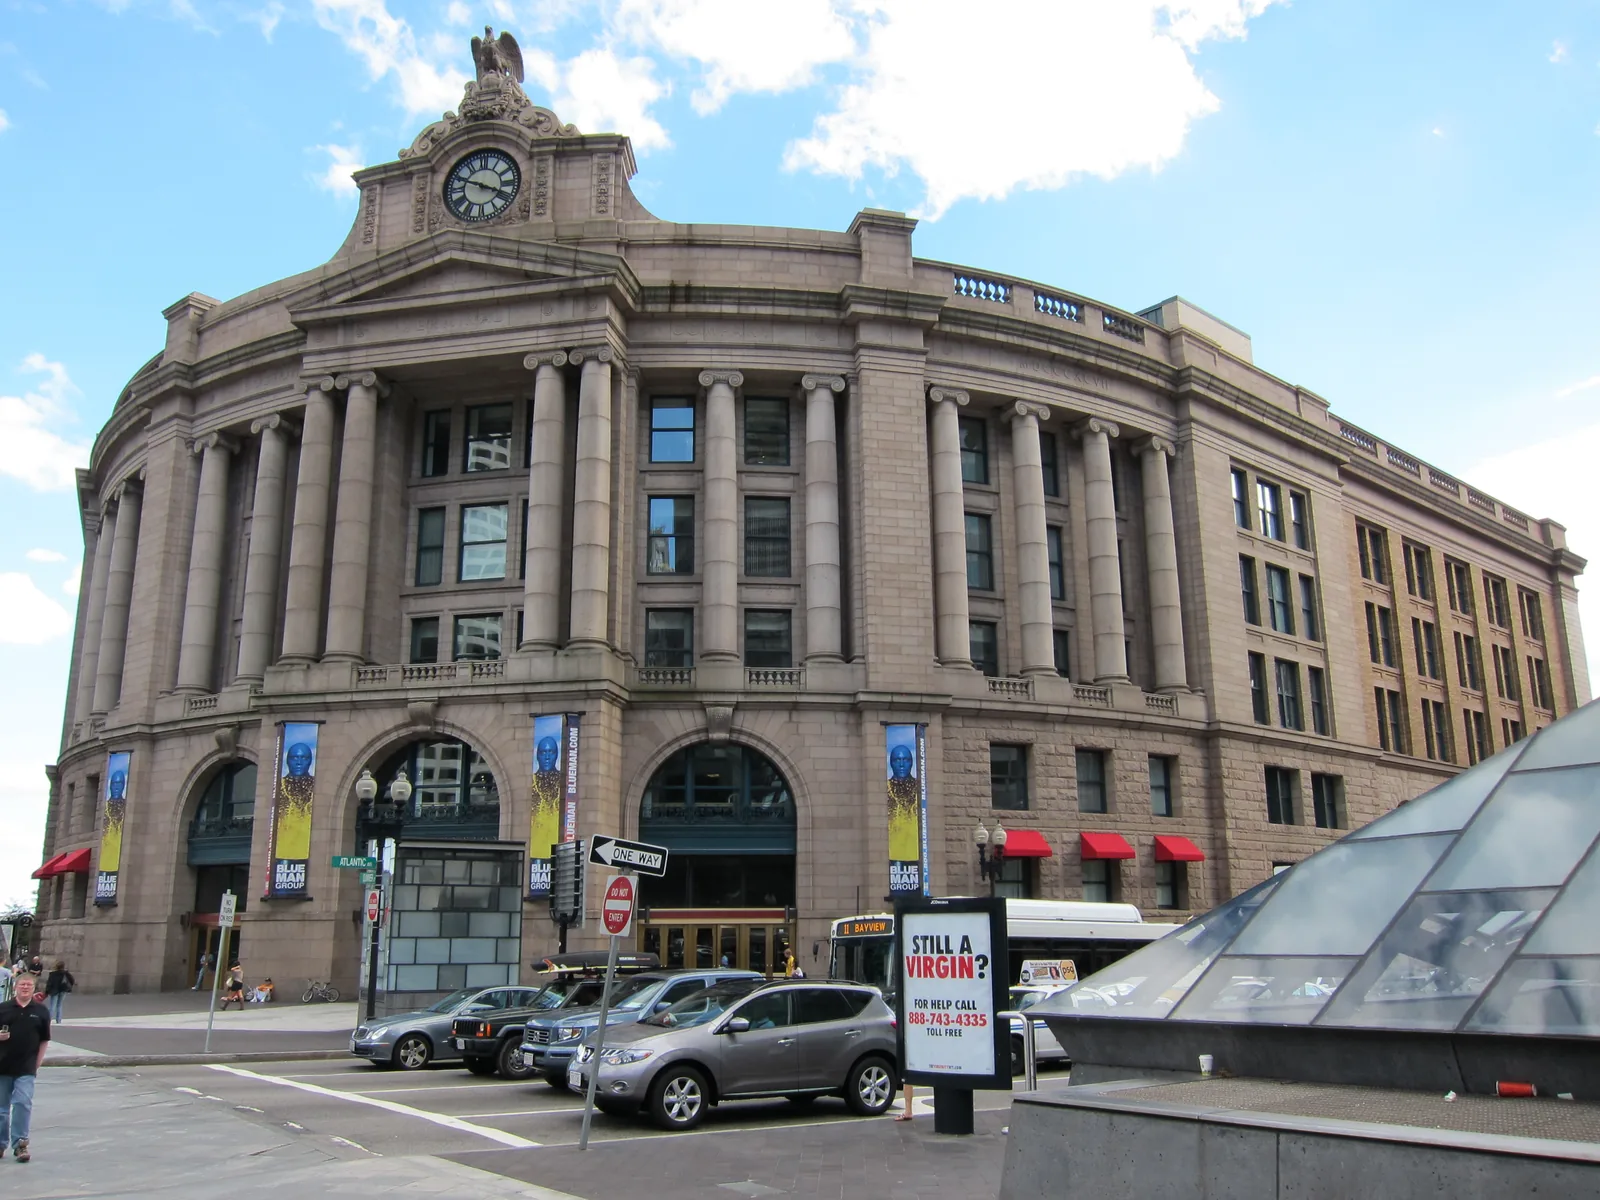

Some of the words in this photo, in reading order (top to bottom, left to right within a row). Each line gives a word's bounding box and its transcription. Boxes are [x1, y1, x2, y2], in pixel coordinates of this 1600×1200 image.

[567, 727, 578, 794] BLUEMAN.COM
[919, 737, 927, 800] BLUEMAN.COM
[566, 801, 576, 842] LUEMAN
[340, 857, 367, 867] ATLANTIC
[613, 847, 634, 862] ONE
[638, 852, 660, 867] WAY
[276, 863, 306, 873] BLUE
[531, 863, 551, 873] BLU
[890, 865, 919, 875] BLUE
[98, 875, 117, 884] BLUE
[275, 872, 305, 883] MAN
[890, 874, 919, 884] MAN
[97, 883, 116, 892] MAN
[530, 882, 551, 890] GROU
[890, 883, 919, 891] GROUP
[610, 888, 619, 897] DO
[619, 888, 629, 897] NOT
[608, 913, 624, 922] ENTER
[844, 924, 850, 935] 11
[854, 922, 887, 933] BAYVIEW
[912, 935, 954, 955] STILL
[959, 935, 973, 955] A
[905, 954, 989, 979] VIRGIN?
[914, 999, 929, 1009] FOR
[930, 1000, 953, 1010] HELP
[955, 1000, 977, 1011] CALL
[908, 1012, 988, 1027] 888-743-4335
[926, 1028, 942, 1036] TOLL
[944, 1029, 963, 1037] FREE
